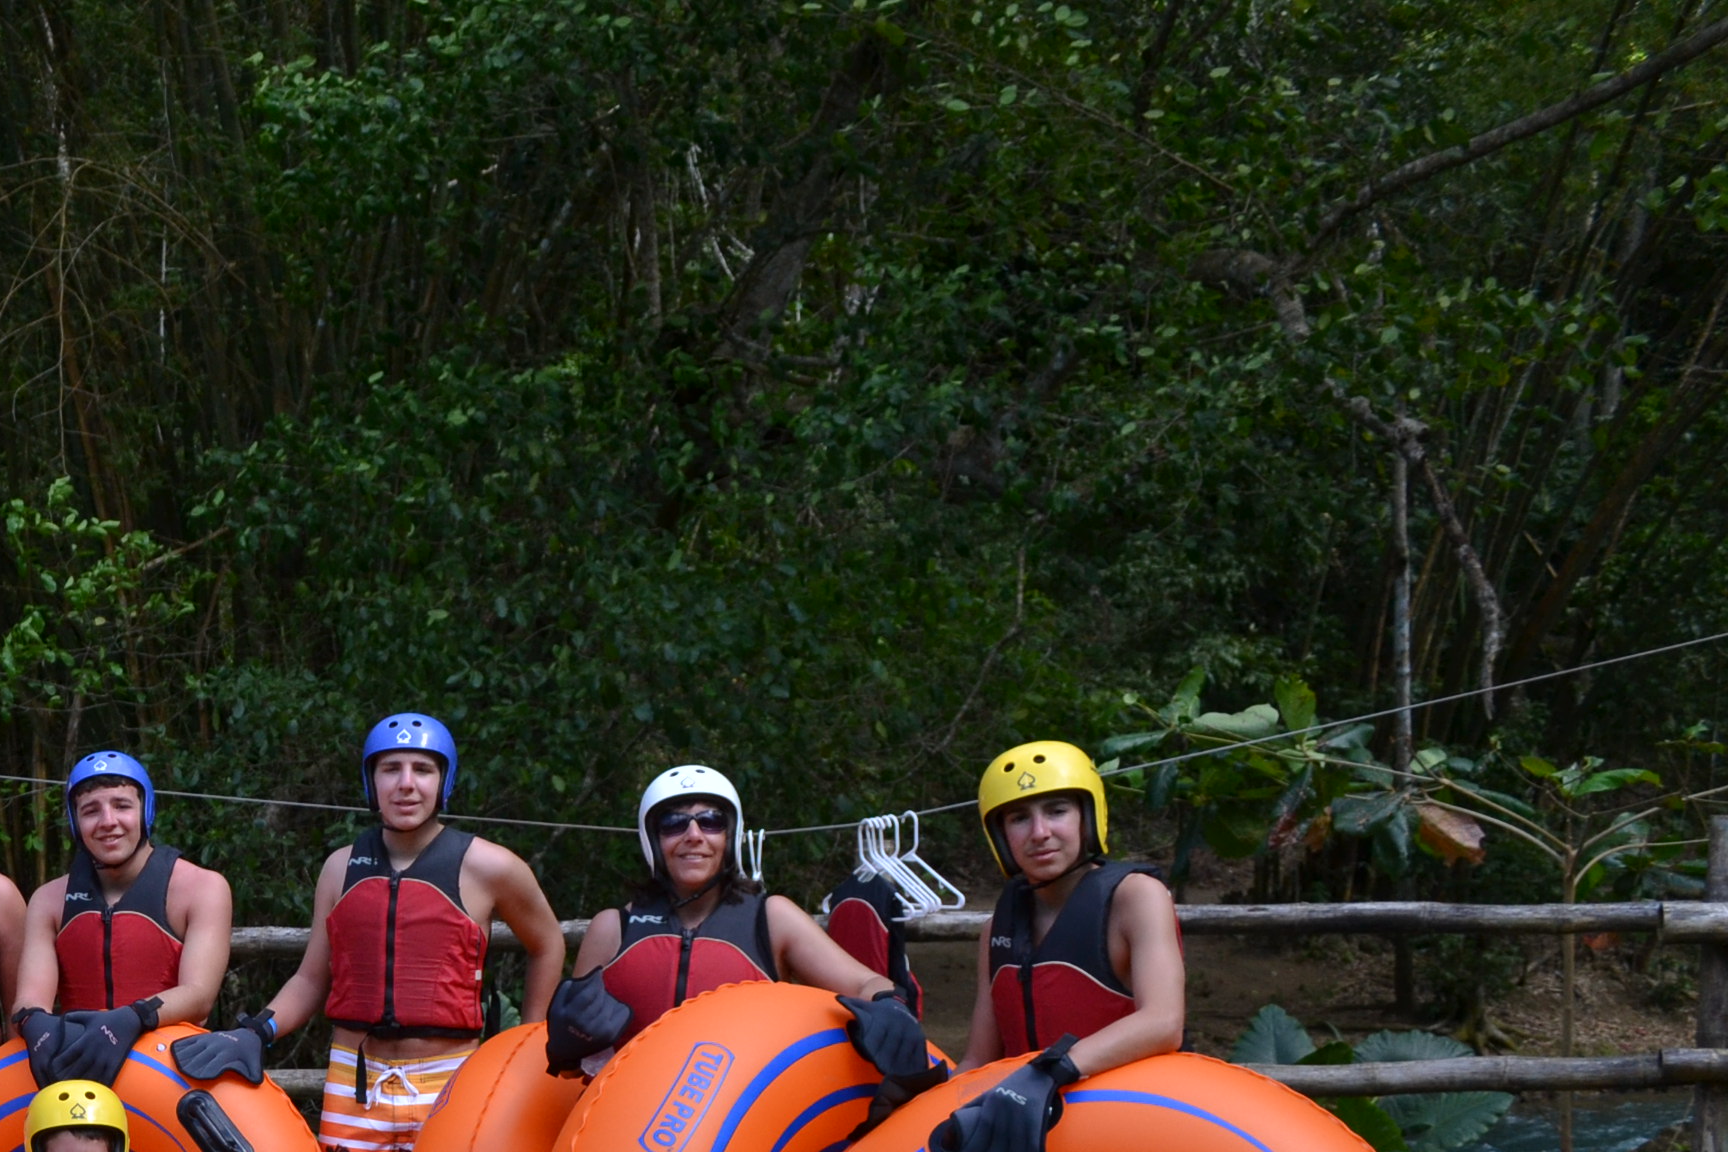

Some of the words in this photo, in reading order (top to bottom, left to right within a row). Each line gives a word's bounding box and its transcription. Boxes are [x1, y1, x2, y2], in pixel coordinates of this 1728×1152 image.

[991, 936, 1012, 948] NRS
[100, 1024, 119, 1046] NRS
[678, 1051, 724, 1104] TUBE
[996, 1086, 1027, 1106] NRS
[653, 1100, 695, 1147] PRO
